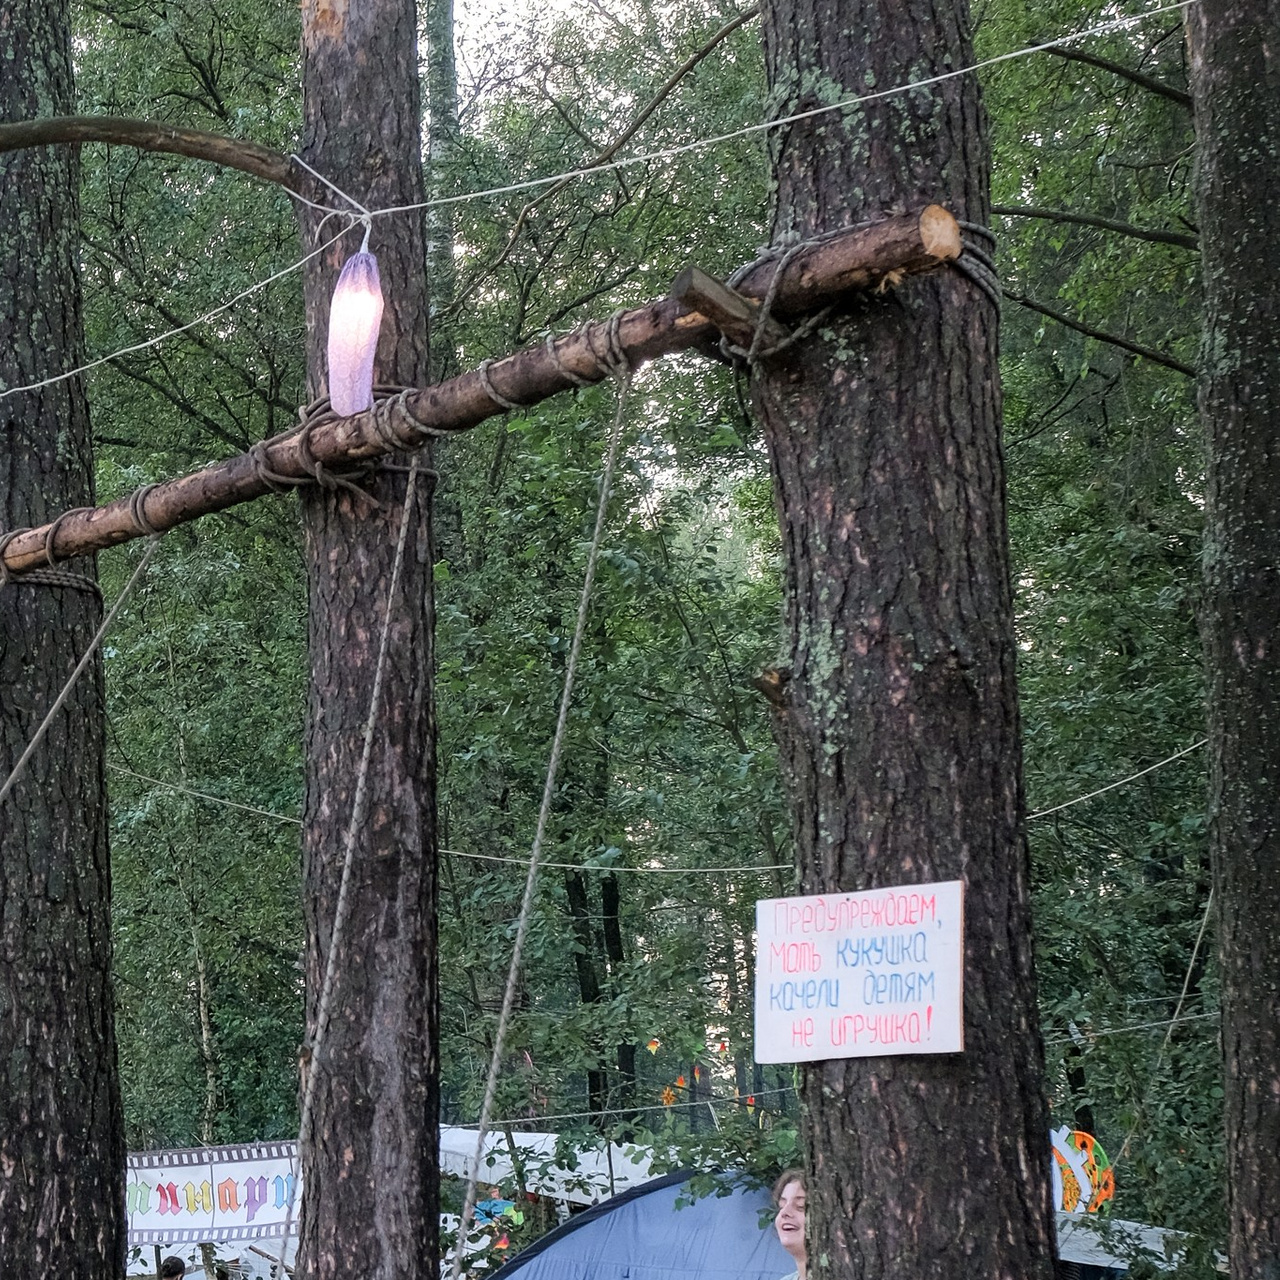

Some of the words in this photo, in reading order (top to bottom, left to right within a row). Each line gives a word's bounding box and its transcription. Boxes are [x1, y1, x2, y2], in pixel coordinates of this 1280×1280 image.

[770, 979, 840, 1011] качели
[863, 969, 935, 1006] детям
[792, 1017, 814, 1047] не
[831, 1005, 933, 1046] игрушка!
